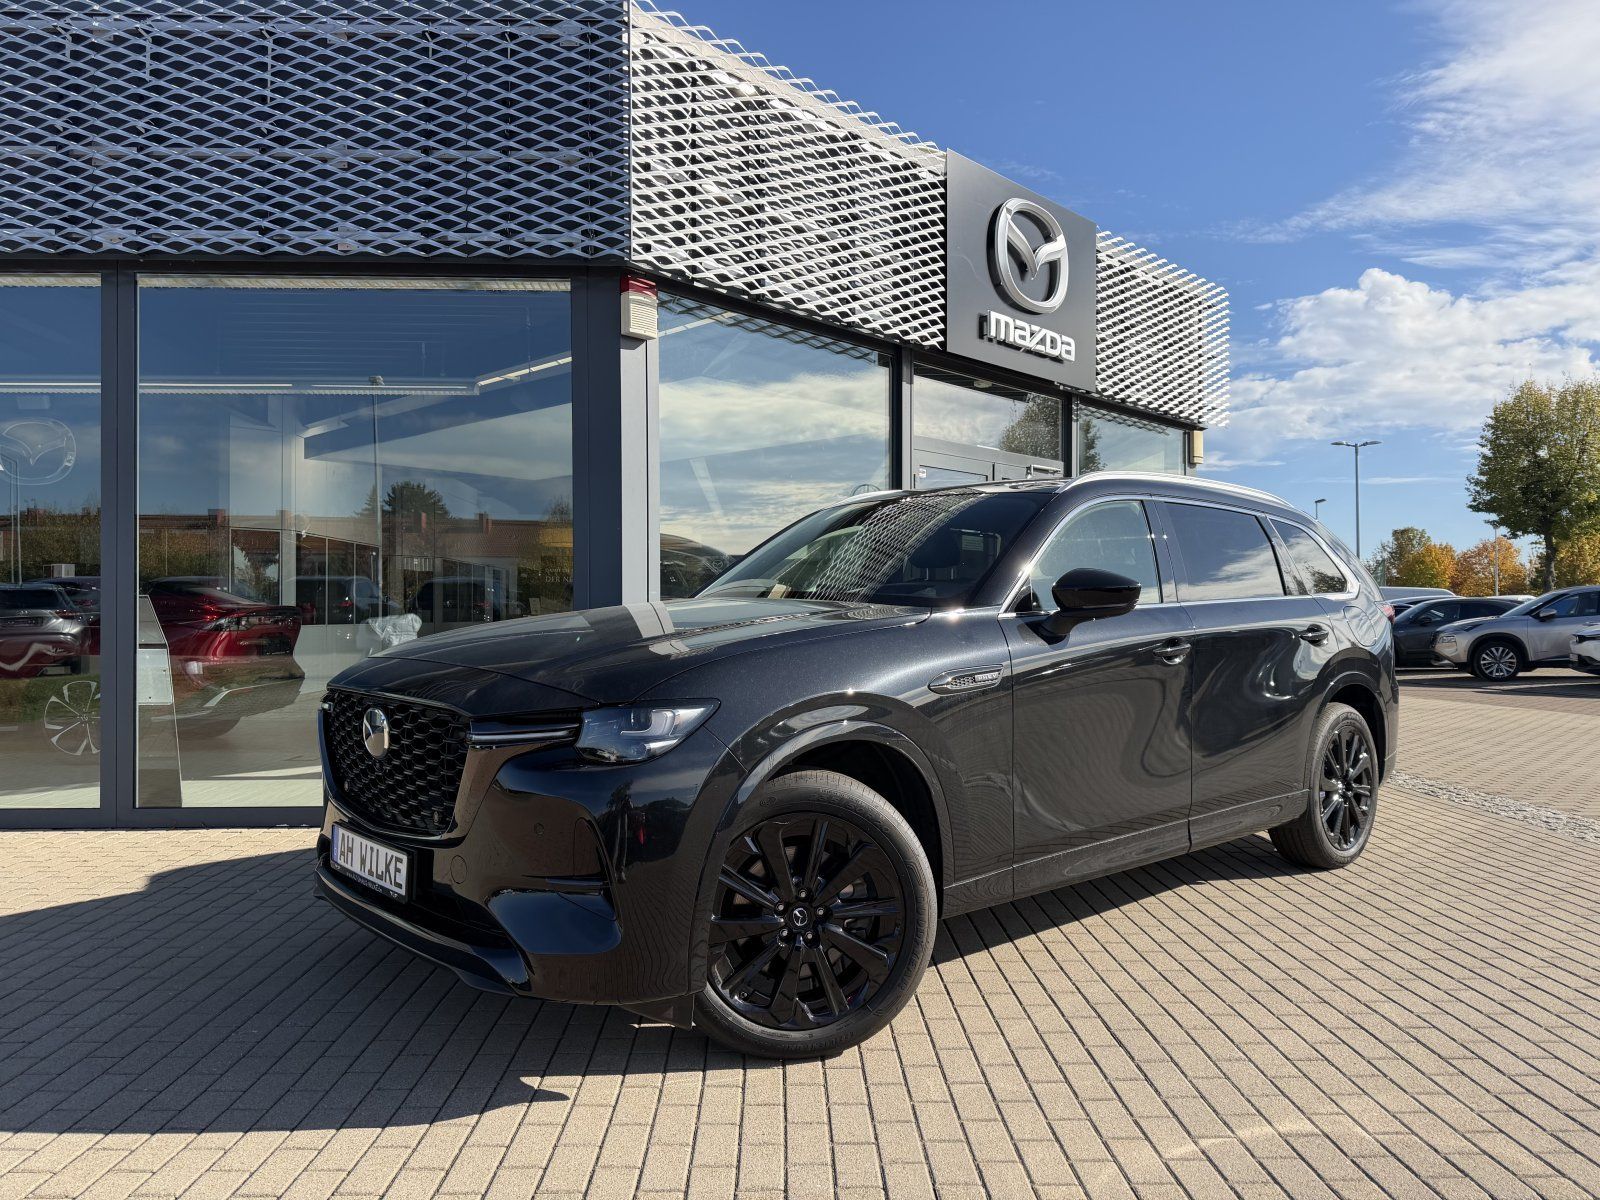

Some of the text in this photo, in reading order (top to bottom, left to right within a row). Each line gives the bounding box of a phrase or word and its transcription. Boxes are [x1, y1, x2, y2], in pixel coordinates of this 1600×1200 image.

[988, 310, 1075, 362] mazda
[339, 832, 355, 868] AH
[360, 841, 404, 890] WILKE
